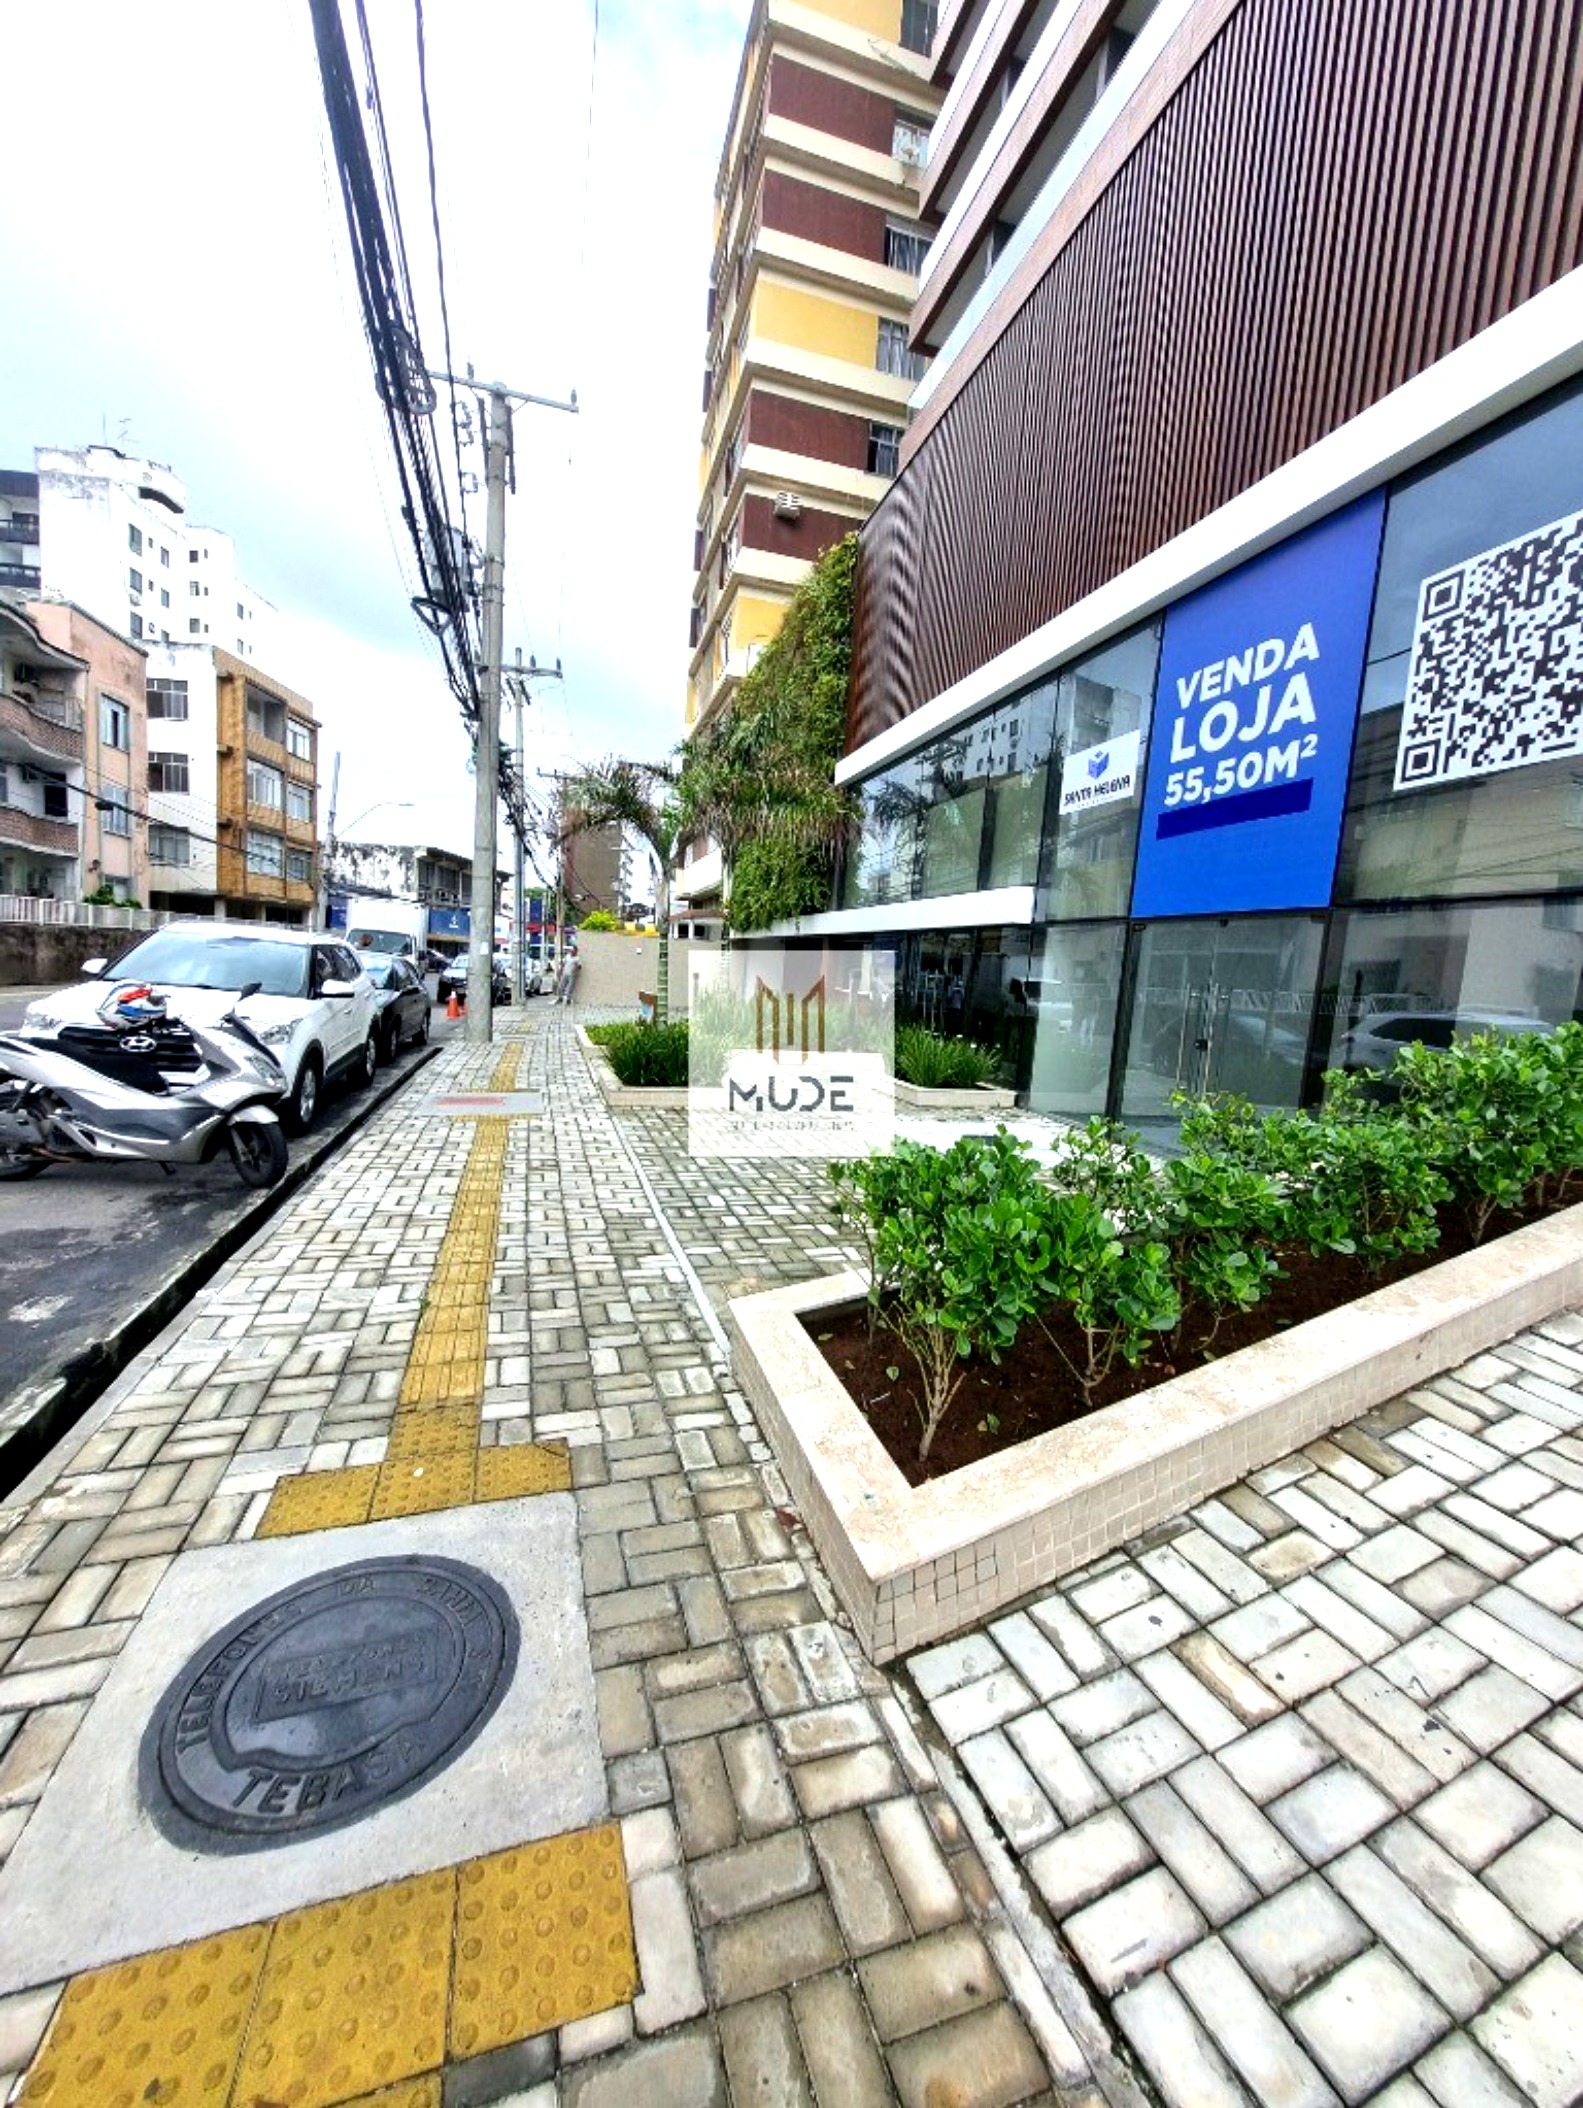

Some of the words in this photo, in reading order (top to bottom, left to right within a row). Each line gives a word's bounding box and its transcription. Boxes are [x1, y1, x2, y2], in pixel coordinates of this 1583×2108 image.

[1176, 622, 1320, 709] VENDA
[1170, 672, 1317, 763] LOJA
[338, 1575, 377, 1596] DA
[231, 1730, 426, 1814] TEBASA
